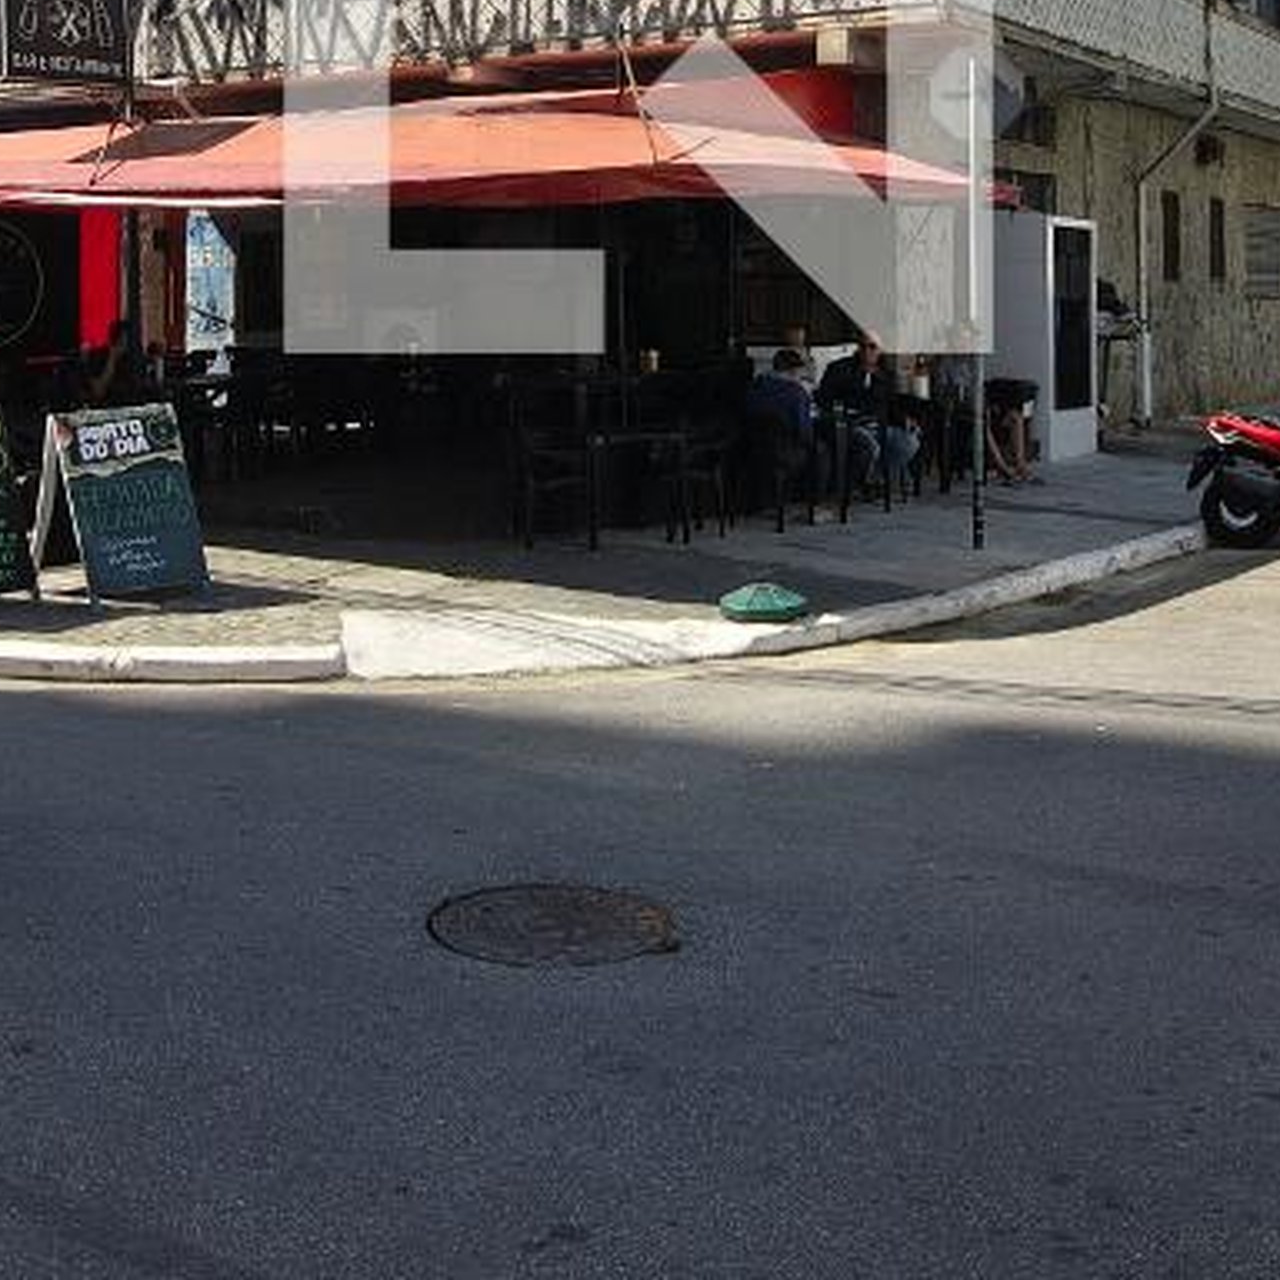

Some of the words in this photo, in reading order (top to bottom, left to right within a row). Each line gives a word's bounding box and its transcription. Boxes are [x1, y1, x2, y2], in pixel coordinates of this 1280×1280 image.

[77, 419, 144, 443] PRATO
[81, 443, 109, 461] DO
[115, 436, 151, 456] DIA
